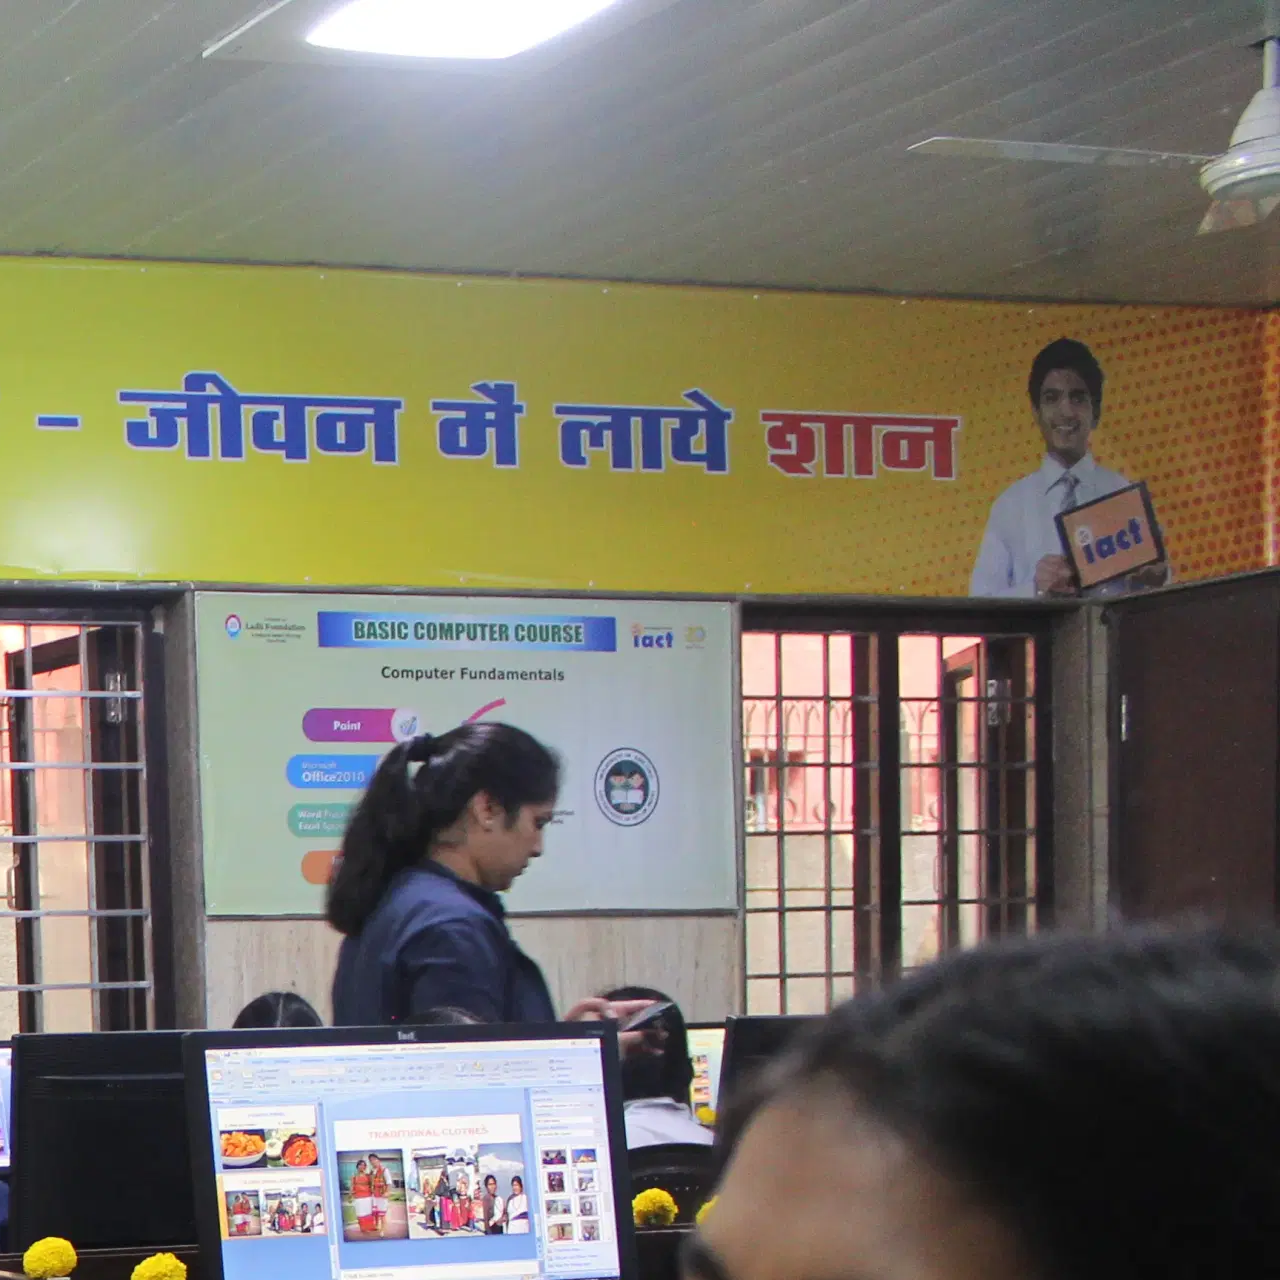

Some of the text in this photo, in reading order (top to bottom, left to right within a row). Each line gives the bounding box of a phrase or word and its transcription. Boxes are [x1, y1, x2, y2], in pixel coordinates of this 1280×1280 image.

[117, 371, 403, 466] जीवन
[553, 388, 733, 474] लाये
[760, 409, 961, 481] शान
[354, 621, 583, 643] BASIC COMPUTER COURSE
[381, 666, 565, 681] Computer Fundamentals
[333, 720, 361, 731] Paint
